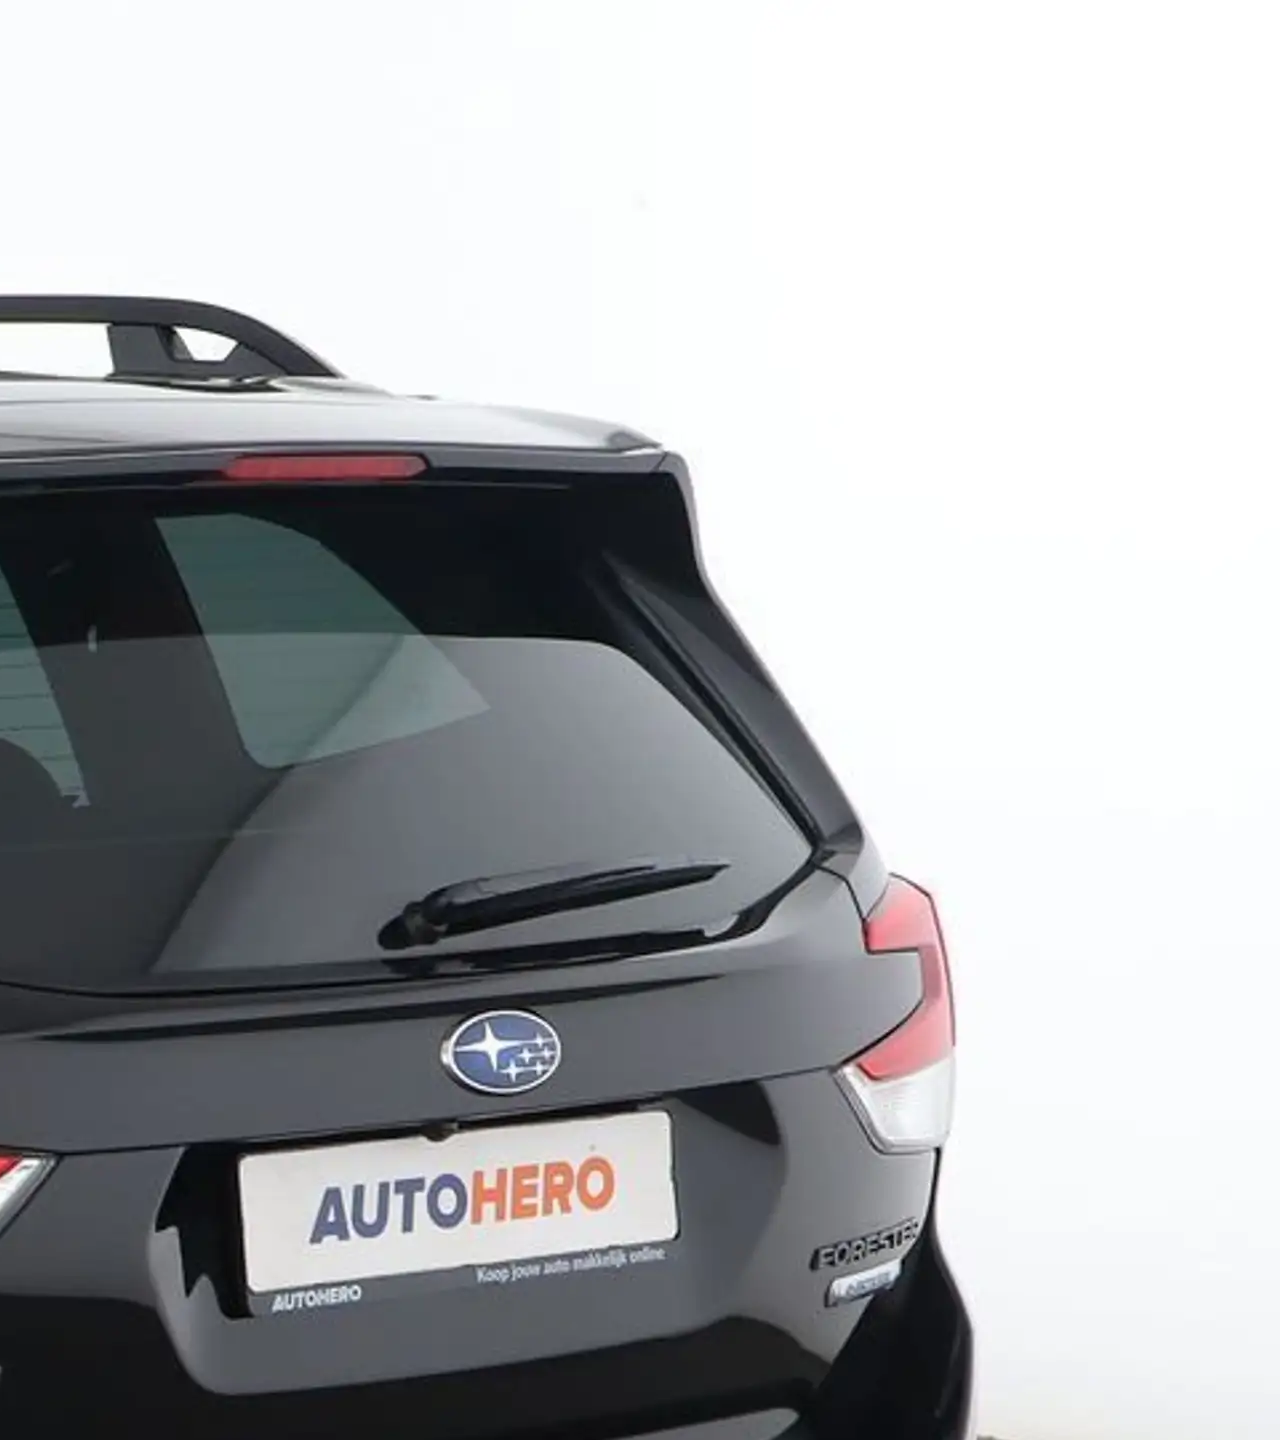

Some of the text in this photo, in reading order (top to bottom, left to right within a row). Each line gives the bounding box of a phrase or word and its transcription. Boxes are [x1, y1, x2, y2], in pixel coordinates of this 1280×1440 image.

[309, 1155, 615, 1245] AUTOHERO
[476, 1266, 510, 1284] Koop
[629, 1245, 666, 1264] online
[272, 1284, 362, 1313] AUTOHERO
